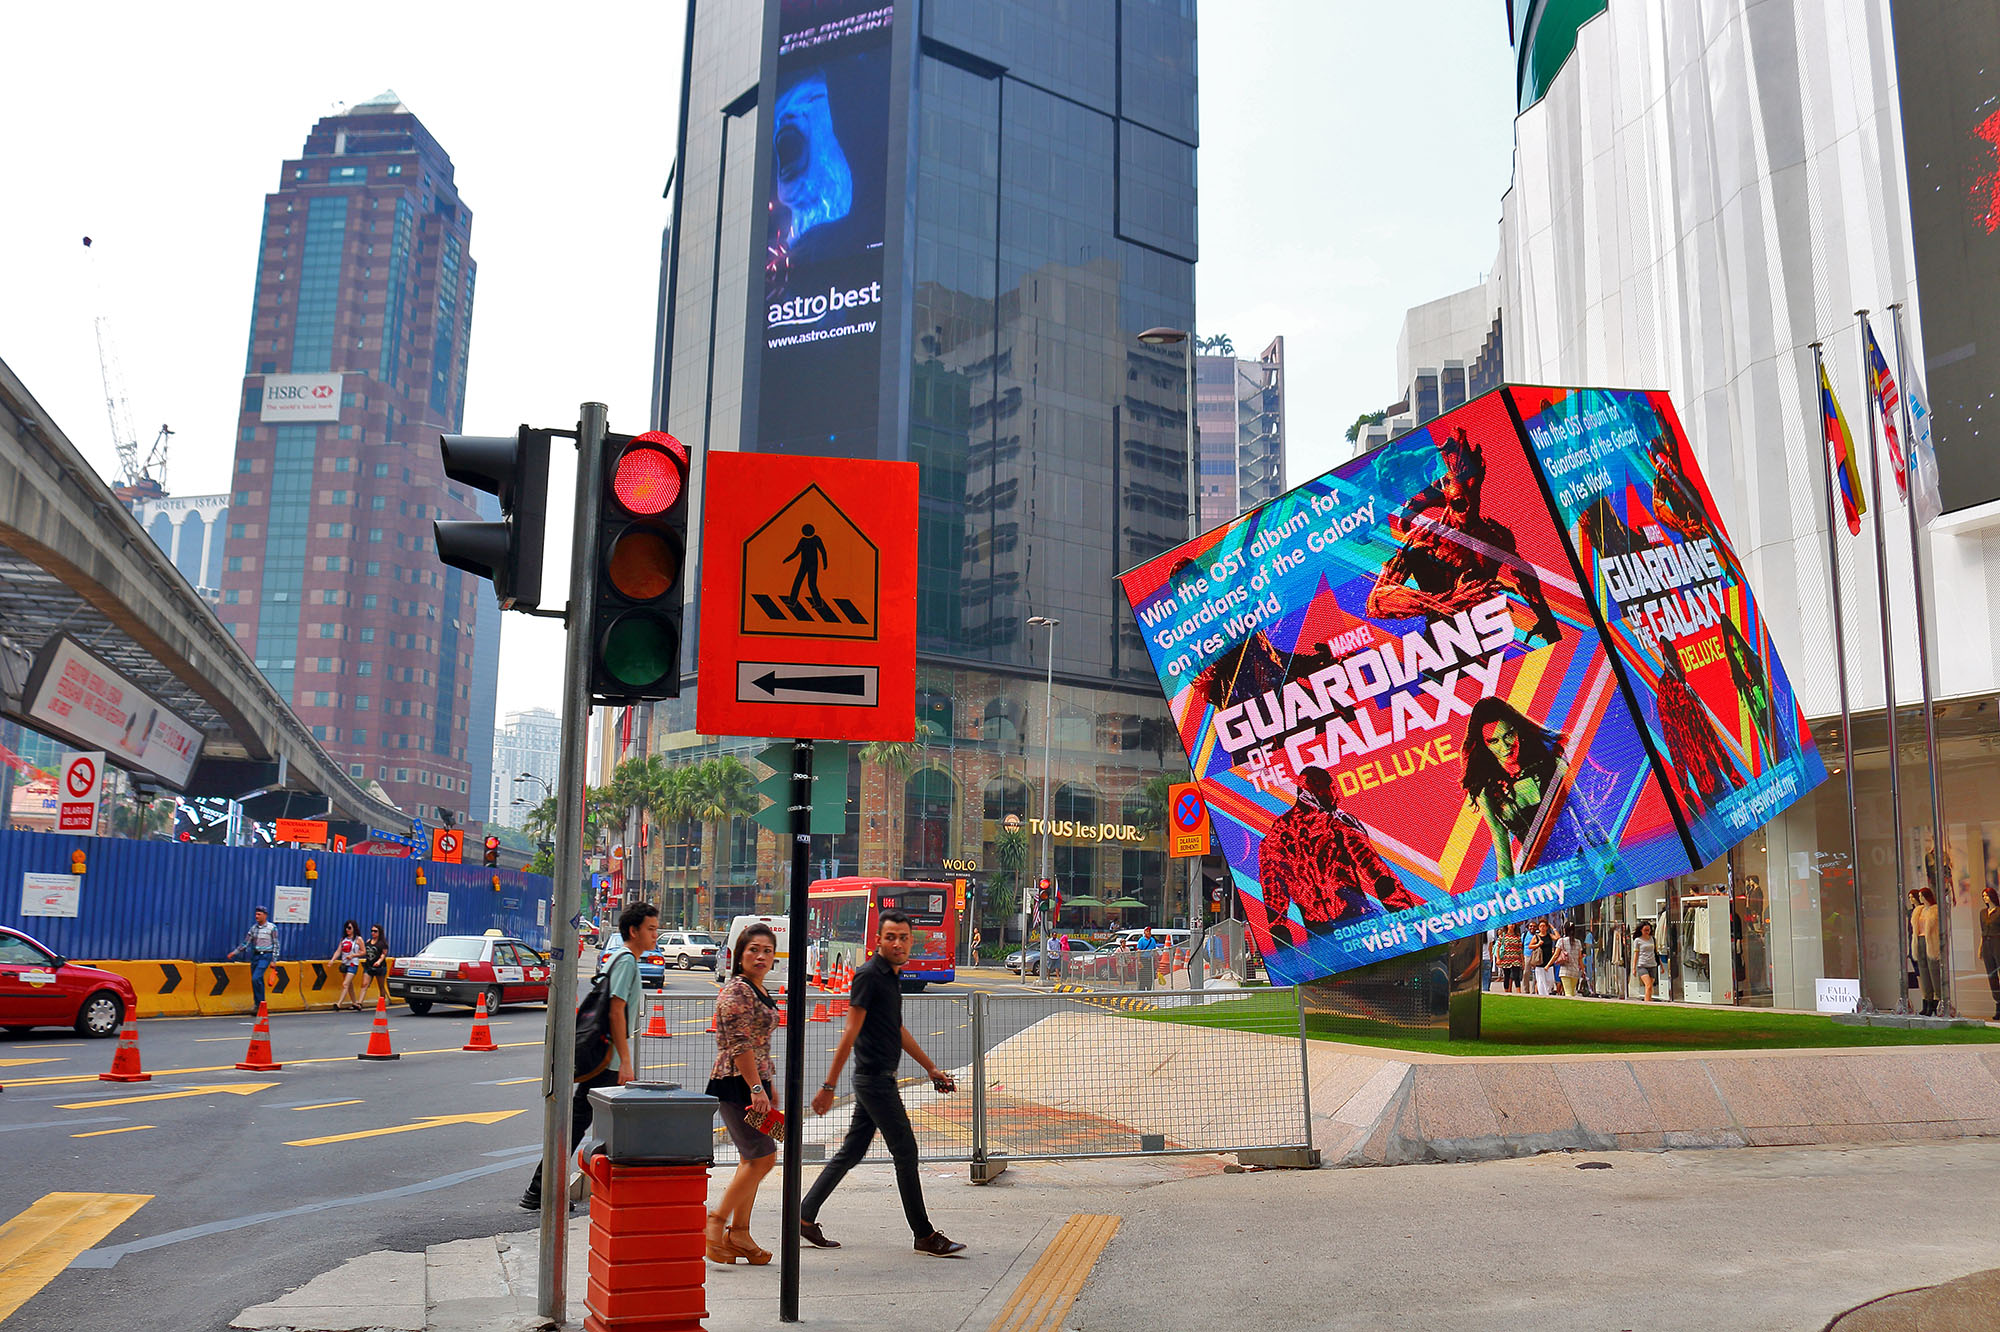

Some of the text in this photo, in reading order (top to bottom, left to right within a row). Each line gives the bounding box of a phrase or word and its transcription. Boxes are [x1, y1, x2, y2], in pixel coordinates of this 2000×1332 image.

[779, 18, 882, 55] SPIDER-MAN
[782, 5, 894, 43] THE AMAZING
[767, 281, 881, 323] astro best
[768, 321, 876, 349] www.astro.com.my
[268, 385, 309, 400] HSBC
[1529, 402, 1620, 450] Win the OST album for
[1590, 438, 1602, 460] of
[1598, 436, 1614, 457] the
[1559, 465, 1612, 508] on Yes World
[155, 496, 229, 511] HOTEL ISTAN
[1140, 489, 1340, 628] Win the OST album for
[1251, 565, 1272, 591] of
[1272, 548, 1306, 577] the
[1599, 537, 1722, 603] GUARDIANS
[1627, 603, 1644, 626] OF
[1644, 581, 1726, 643] GALAXY
[1167, 592, 1281, 677] on Yes World
[1327, 625, 1375, 657] MARVEL
[1632, 624, 1658, 650] THE
[1677, 635, 1727, 673] DELUXE
[1212, 594, 1516, 753] GUARDIANS
[1283, 652, 1506, 776] GALAXY
[1247, 742, 1274, 770] OF
[1337, 734, 1460, 798] DELUXE
[1247, 763, 1291, 793] THE
[63, 806, 92, 815] DILARANG
[199, 805, 225, 819] TISSOT
[1730, 799, 1751, 830] visit
[1748, 774, 1798, 824] yesworld.my
[62, 817, 90, 826] MELINTAS
[1029, 818, 1074, 837] TOUS
[1075, 821, 1097, 838] les
[1179, 836, 1200, 845] DILARANG
[1180, 844, 1199, 852] BERHENTI
[942, 858, 977, 871] WOLO
[1333, 918, 1379, 941] SONGS
[1514, 857, 1582, 887] PICTURE
[1362, 920, 1408, 953] visit
[1413, 879, 1566, 944] yesworld.my
[1819, 993, 1858, 1003] FASHION
[1827, 986, 1850, 994] FALL
